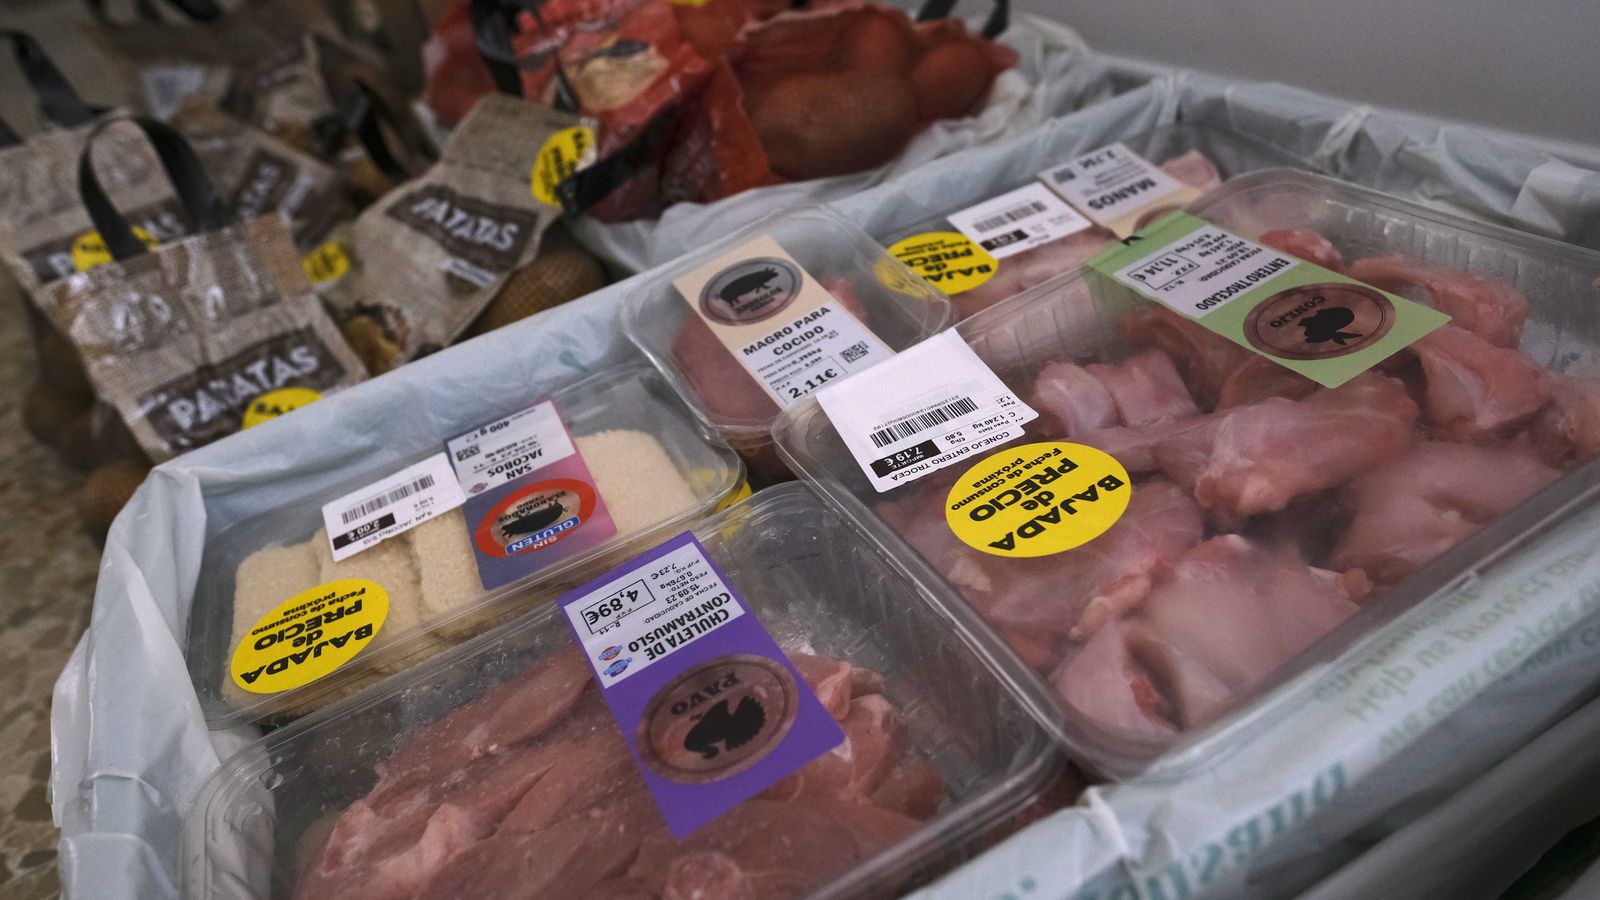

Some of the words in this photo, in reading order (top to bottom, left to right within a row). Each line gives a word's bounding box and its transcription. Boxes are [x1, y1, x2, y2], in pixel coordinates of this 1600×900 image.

[1132, 272, 1148, 280] €
[1140, 256, 1179, 275] 11,14
[1243, 257, 1291, 283] ENTERO
[1192, 278, 1253, 311] TROCEADO
[1267, 295, 1328, 330] CONEJO
[741, 325, 794, 355] MAGRO
[792, 305, 831, 328] PARA
[771, 324, 825, 356] COCIDO
[168, 346, 320, 430] PATATAS
[786, 367, 840, 399] 2,11€
[479, 427, 487, 436] g
[488, 419, 510, 433] 400
[943, 430, 963, 441] 5,80
[970, 430, 1009, 450] CONEJO
[486, 447, 544, 478] JACOBOS
[883, 456, 895, 466] €
[931, 445, 969, 465] ENTERO
[1021, 447, 1063, 471] Fecha
[505, 462, 532, 480] SAN
[890, 462, 928, 481] TROCEA
[970, 457, 1026, 490] próxima
[1005, 468, 1025, 481] de
[949, 477, 1007, 511] consumo
[966, 456, 1079, 525] PRECIO
[1019, 488, 1059, 516] de
[987, 472, 1124, 560] BAJADA
[510, 518, 574, 551] GLUTEN
[532, 534, 557, 550] SIN
[689, 570, 708, 582] PESO
[328, 587, 366, 605] Fecha
[664, 582, 700, 604] 15.09.23
[683, 594, 694, 602] DE
[694, 581, 717, 596] FECHA
[283, 592, 336, 616] próxima
[310, 604, 326, 615] de
[582, 585, 642, 625] 4,89€
[641, 600, 684, 625] CADUCIDAD:
[251, 610, 307, 636] consumo
[254, 599, 362, 650] PRECIO
[625, 591, 732, 653] CONTRAMUSLO
[663, 607, 731, 649] CHULETA
[292, 629, 323, 648] de
[239, 623, 373, 685] BAJADA
[643, 641, 666, 661] DE
[667, 672, 742, 717] PAVO
